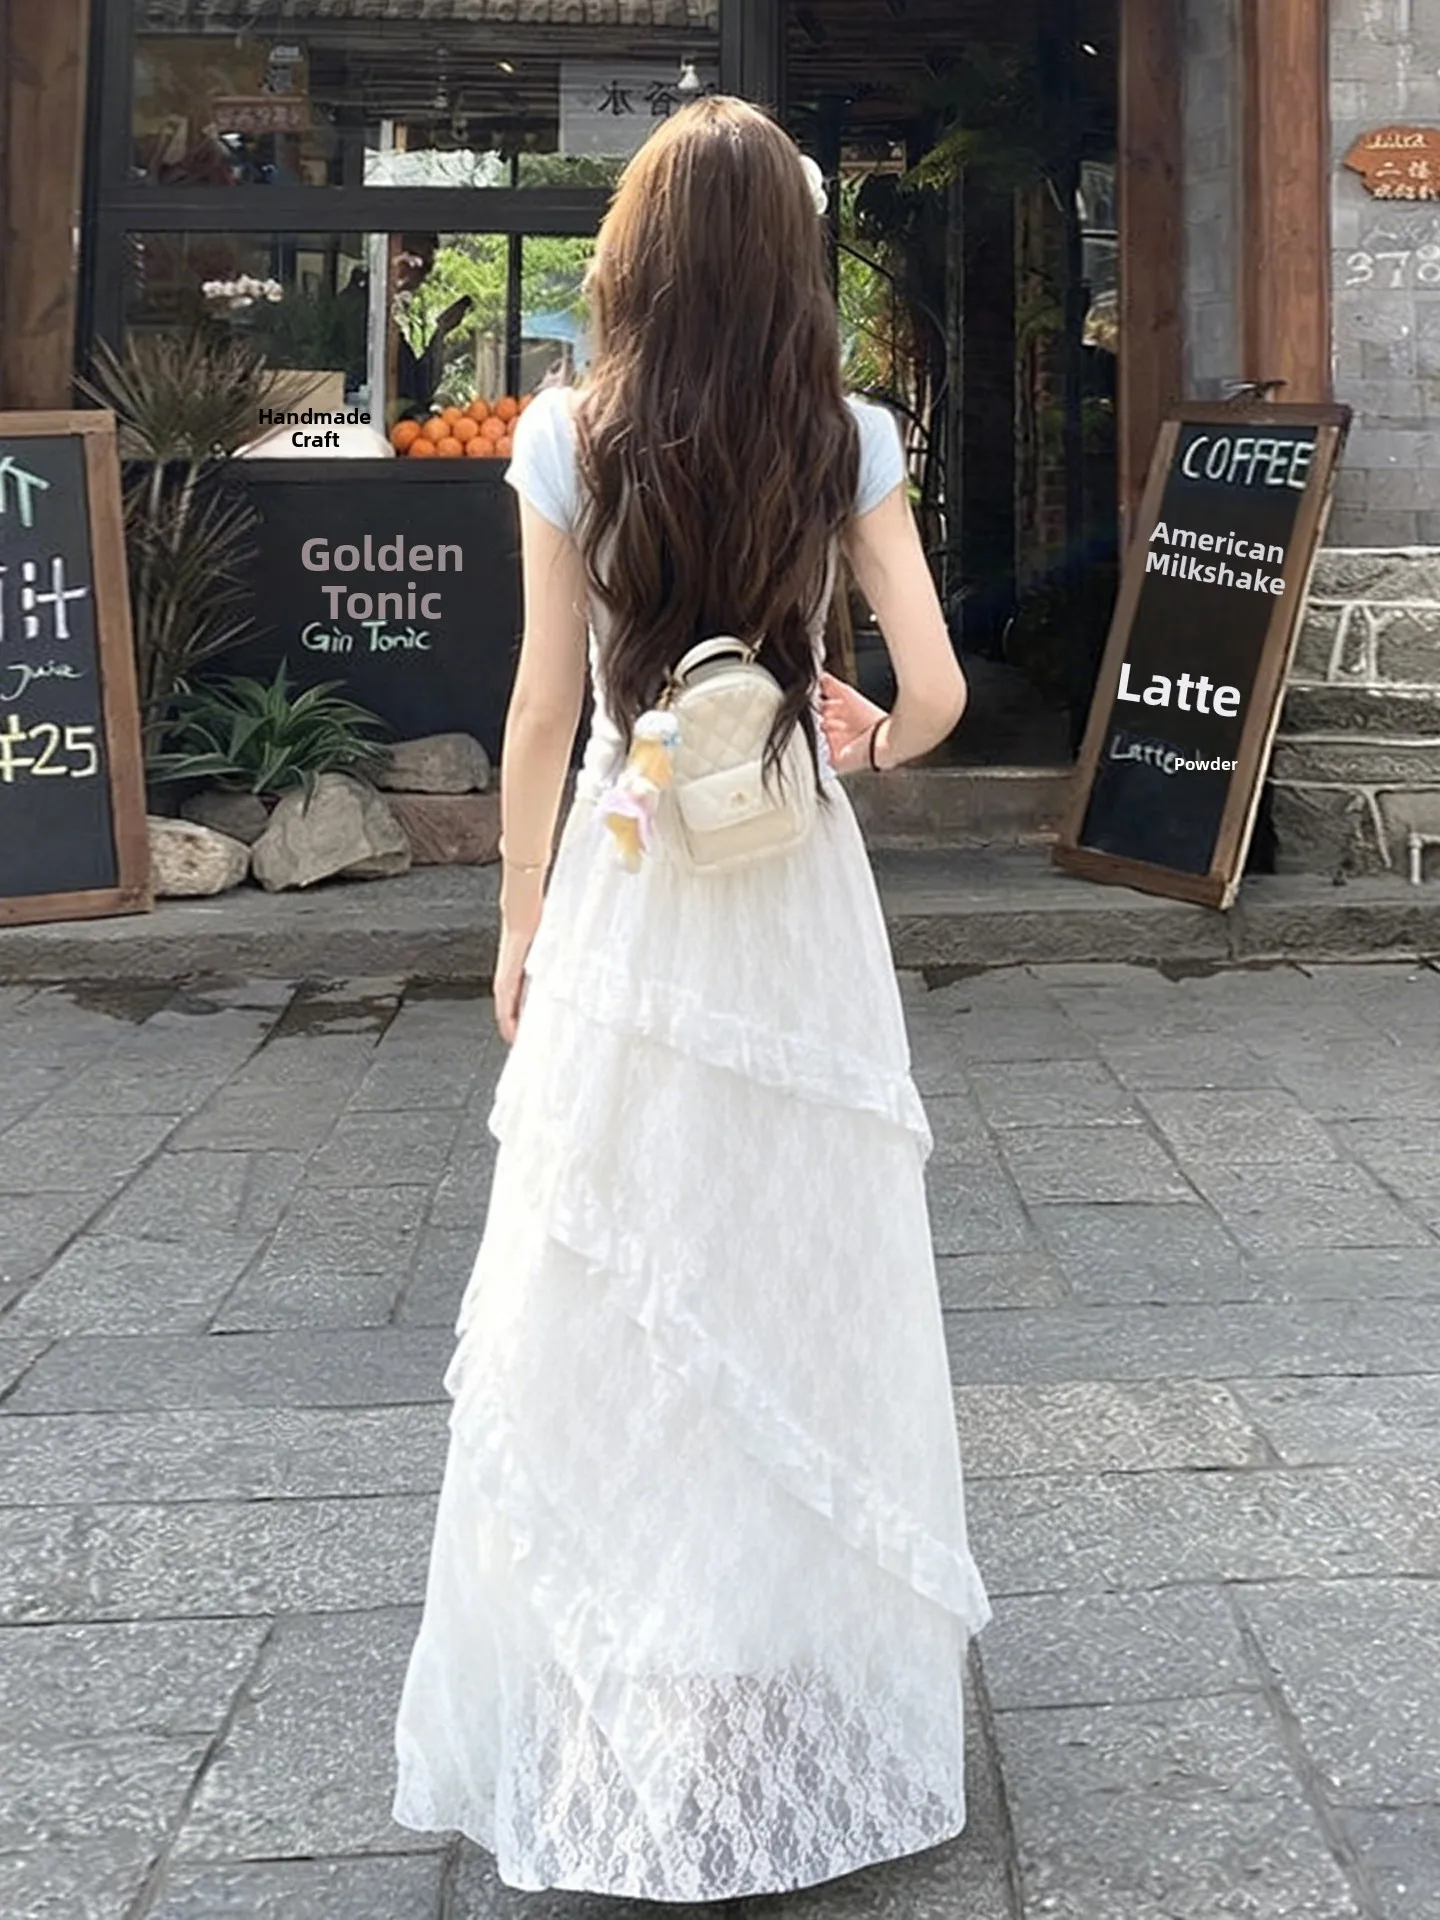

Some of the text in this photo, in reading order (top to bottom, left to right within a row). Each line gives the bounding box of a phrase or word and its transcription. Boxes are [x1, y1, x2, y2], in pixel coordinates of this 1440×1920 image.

[1180, 435, 1316, 490] COFFEE
[0, 557, 88, 639] 汁
[301, 620, 431, 653] Gin Tonic
